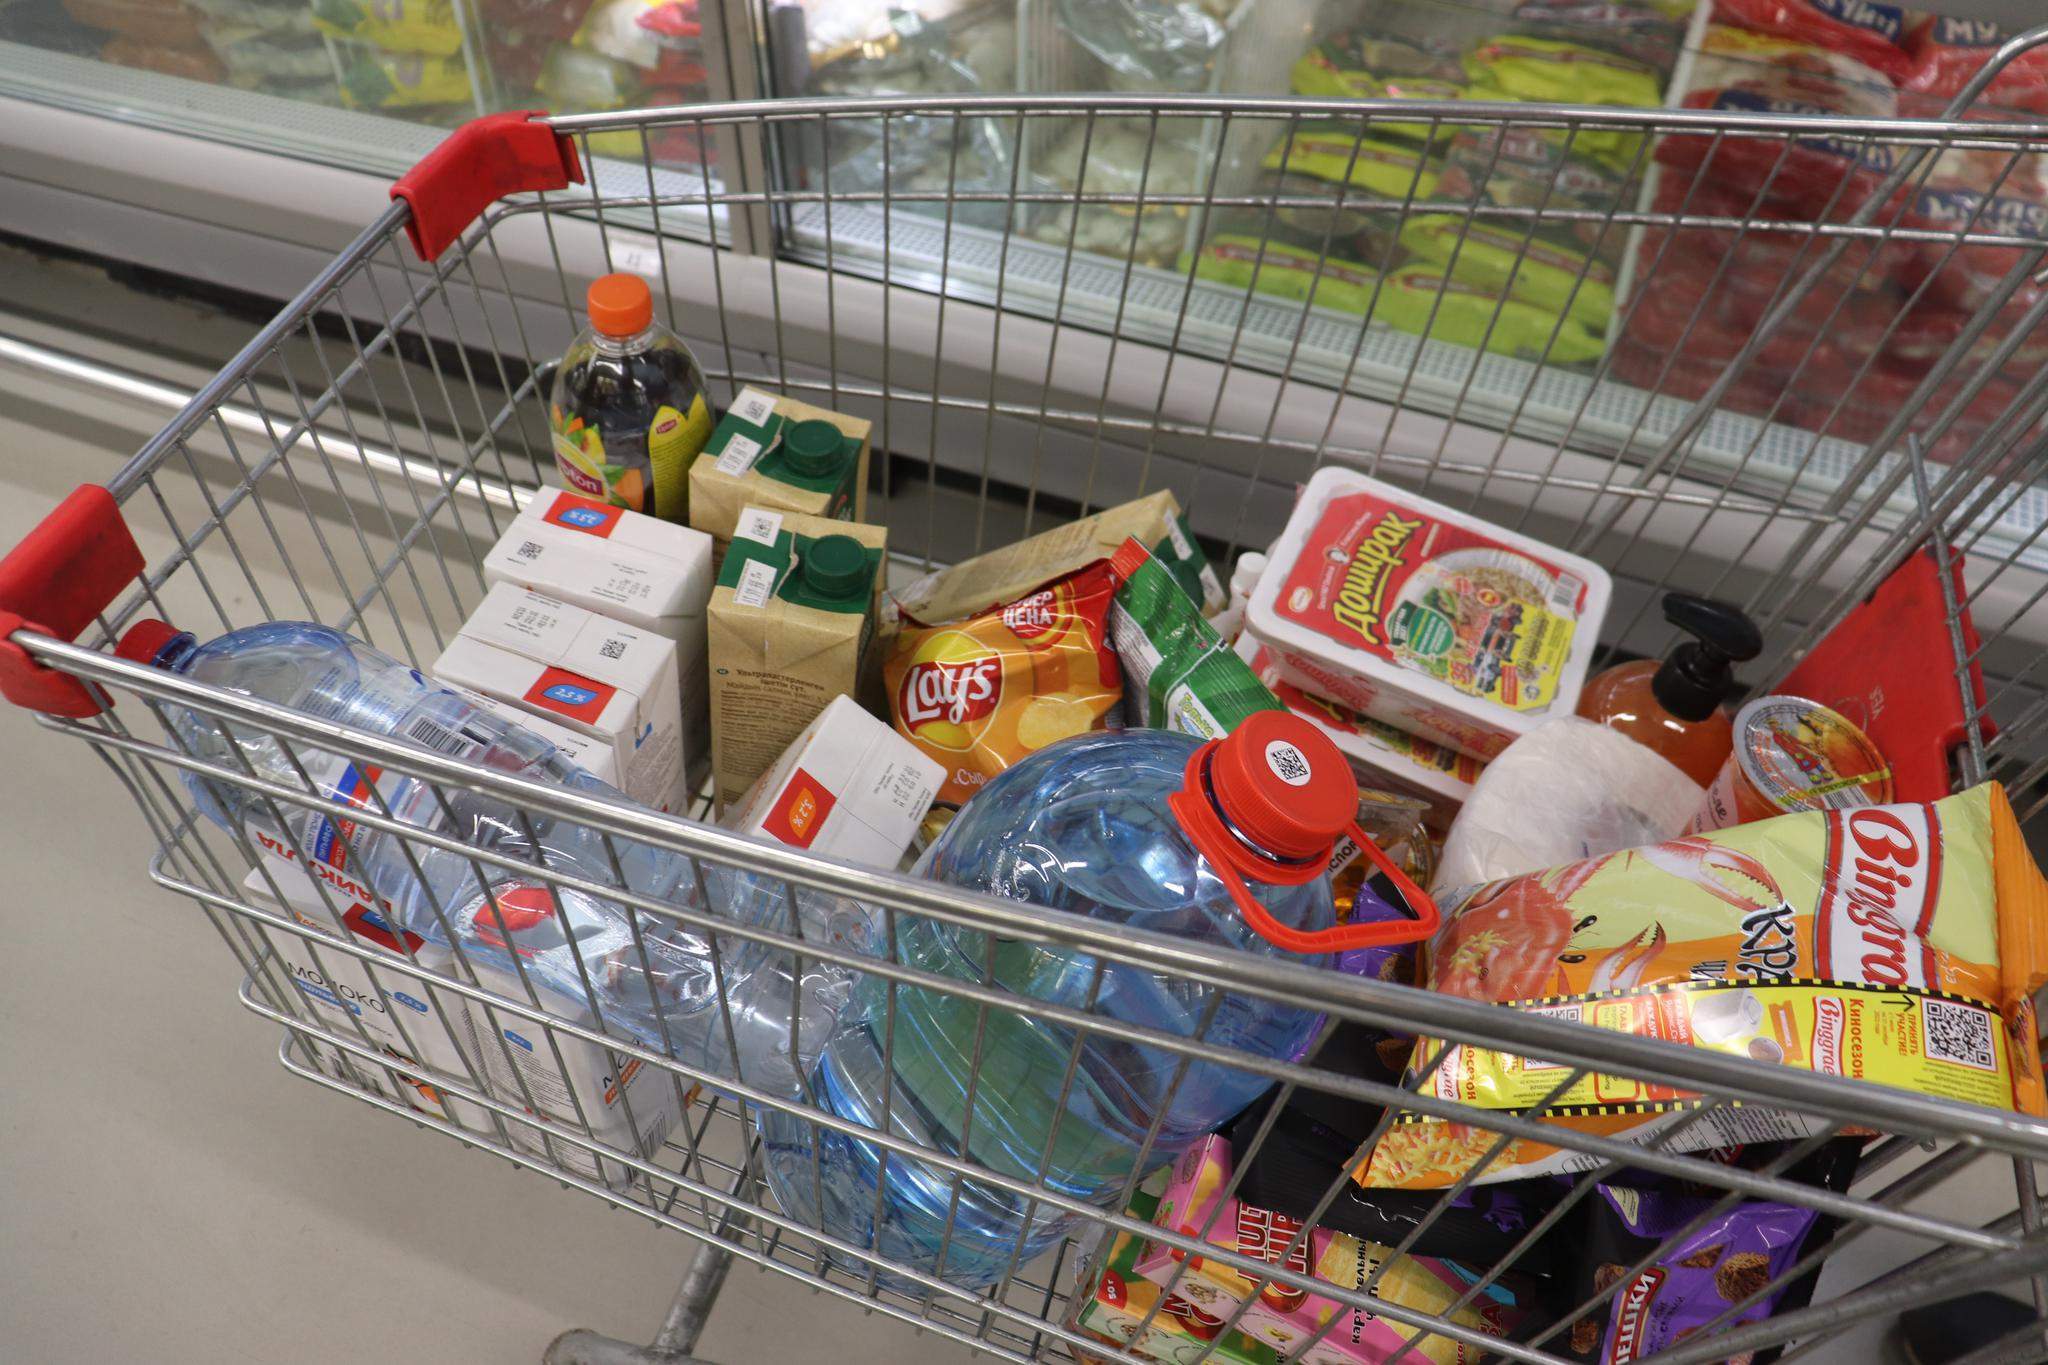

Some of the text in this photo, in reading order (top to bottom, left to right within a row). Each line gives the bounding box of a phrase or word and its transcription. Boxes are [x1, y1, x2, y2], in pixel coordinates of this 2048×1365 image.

[1333, 511, 1425, 645] Доширак
[1003, 603, 1053, 628] ЦЕНА
[905, 656, 997, 724] Lay's
[1736, 901, 1797, 979] КРА
[287, 961, 386, 1014] МООКО
[1816, 996, 1843, 1076] Binggrae
[1848, 997, 1864, 1080] Киносезон
[1896, 1012, 1908, 1057] УЧАСТИЕ!
[1907, 1012, 1920, 1056] ПРИНЯТЬ
[1108, 1284, 1118, 1300] 50
[1352, 1239, 1368, 1344] картельны
[1613, 1271, 1658, 1365] ЕШКИ
